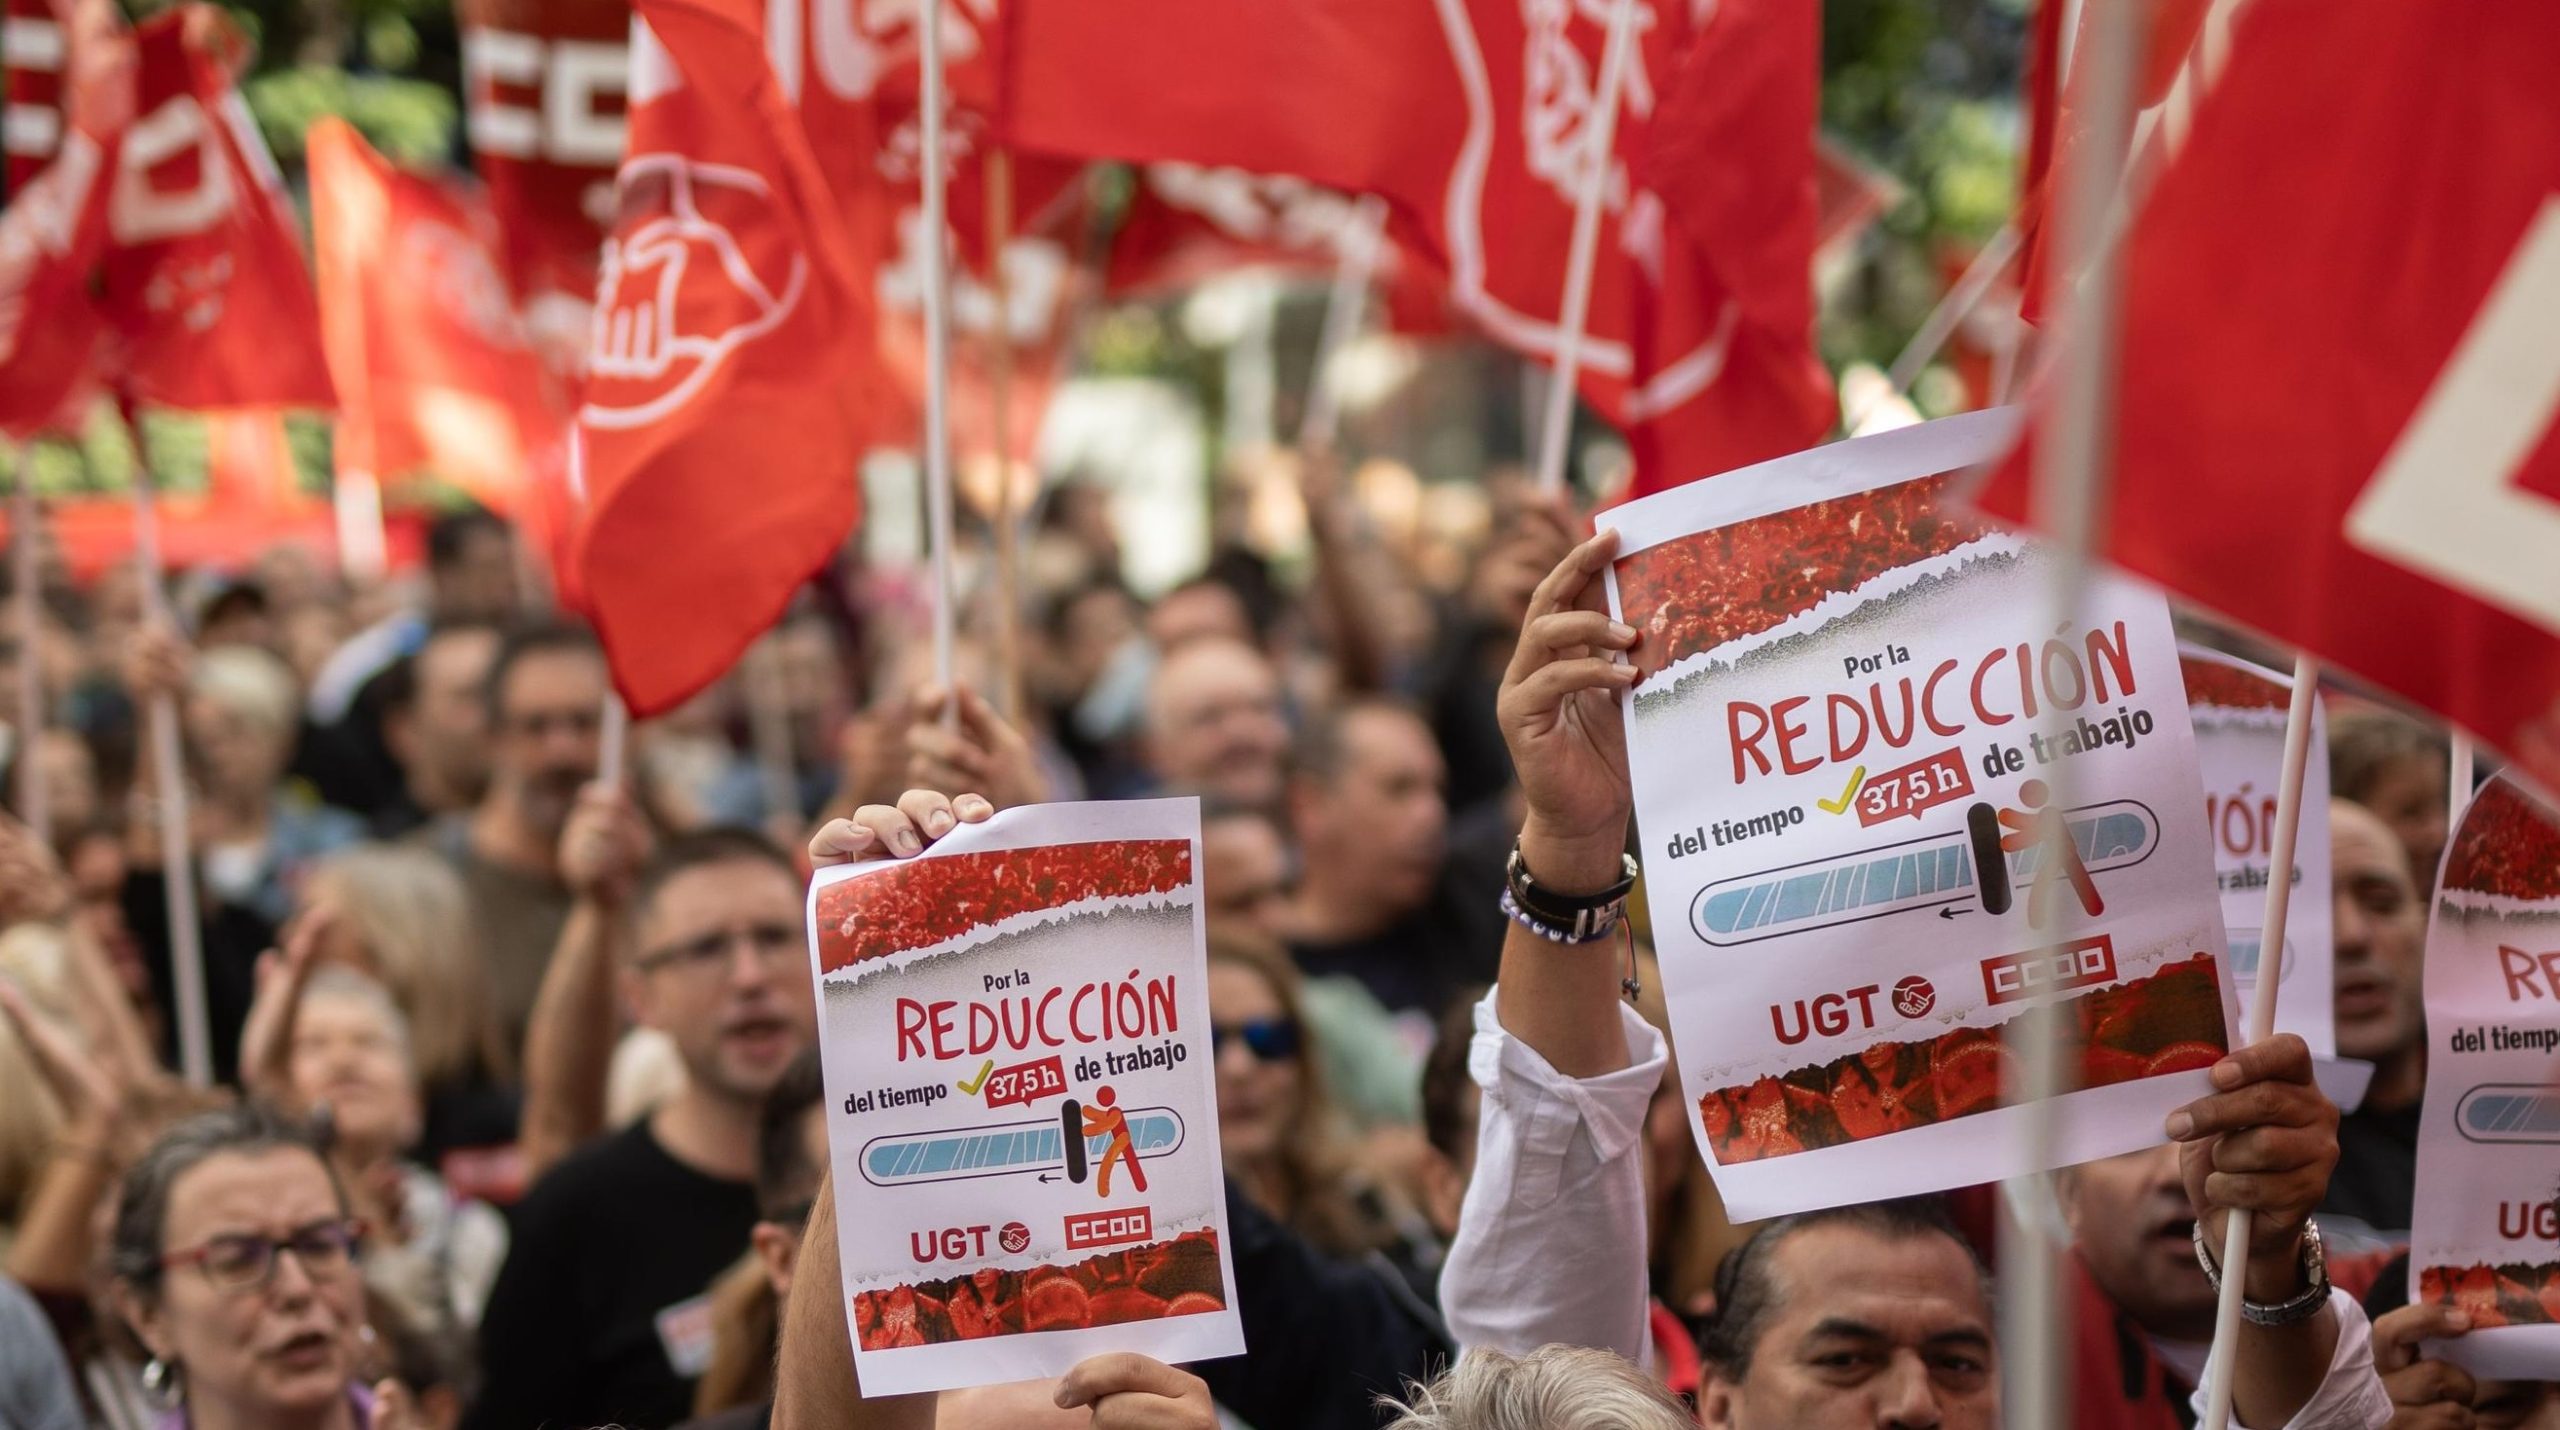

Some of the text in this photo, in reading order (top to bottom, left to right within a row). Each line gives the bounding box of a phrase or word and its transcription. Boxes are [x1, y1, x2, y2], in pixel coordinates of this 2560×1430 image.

[1844, 644, 1910, 678] Por la
[1727, 620, 2136, 785] REDUCCIÓN
[1667, 705, 2154, 859] del tiempo 37,5 h de trabajo
[983, 968, 1031, 993] Por la
[1992, 946, 2107, 994] CCOO
[896, 968, 1178, 1062] REDUCCIÓN
[1770, 983, 1880, 1045] UGT
[2450, 1025, 2560, 1055] del tiemp
[843, 1039, 1188, 1115] del tiempo 37,5 h de trabajo
[911, 1224, 991, 1264] UGT
[1071, 1214, 1146, 1242] CCOO
